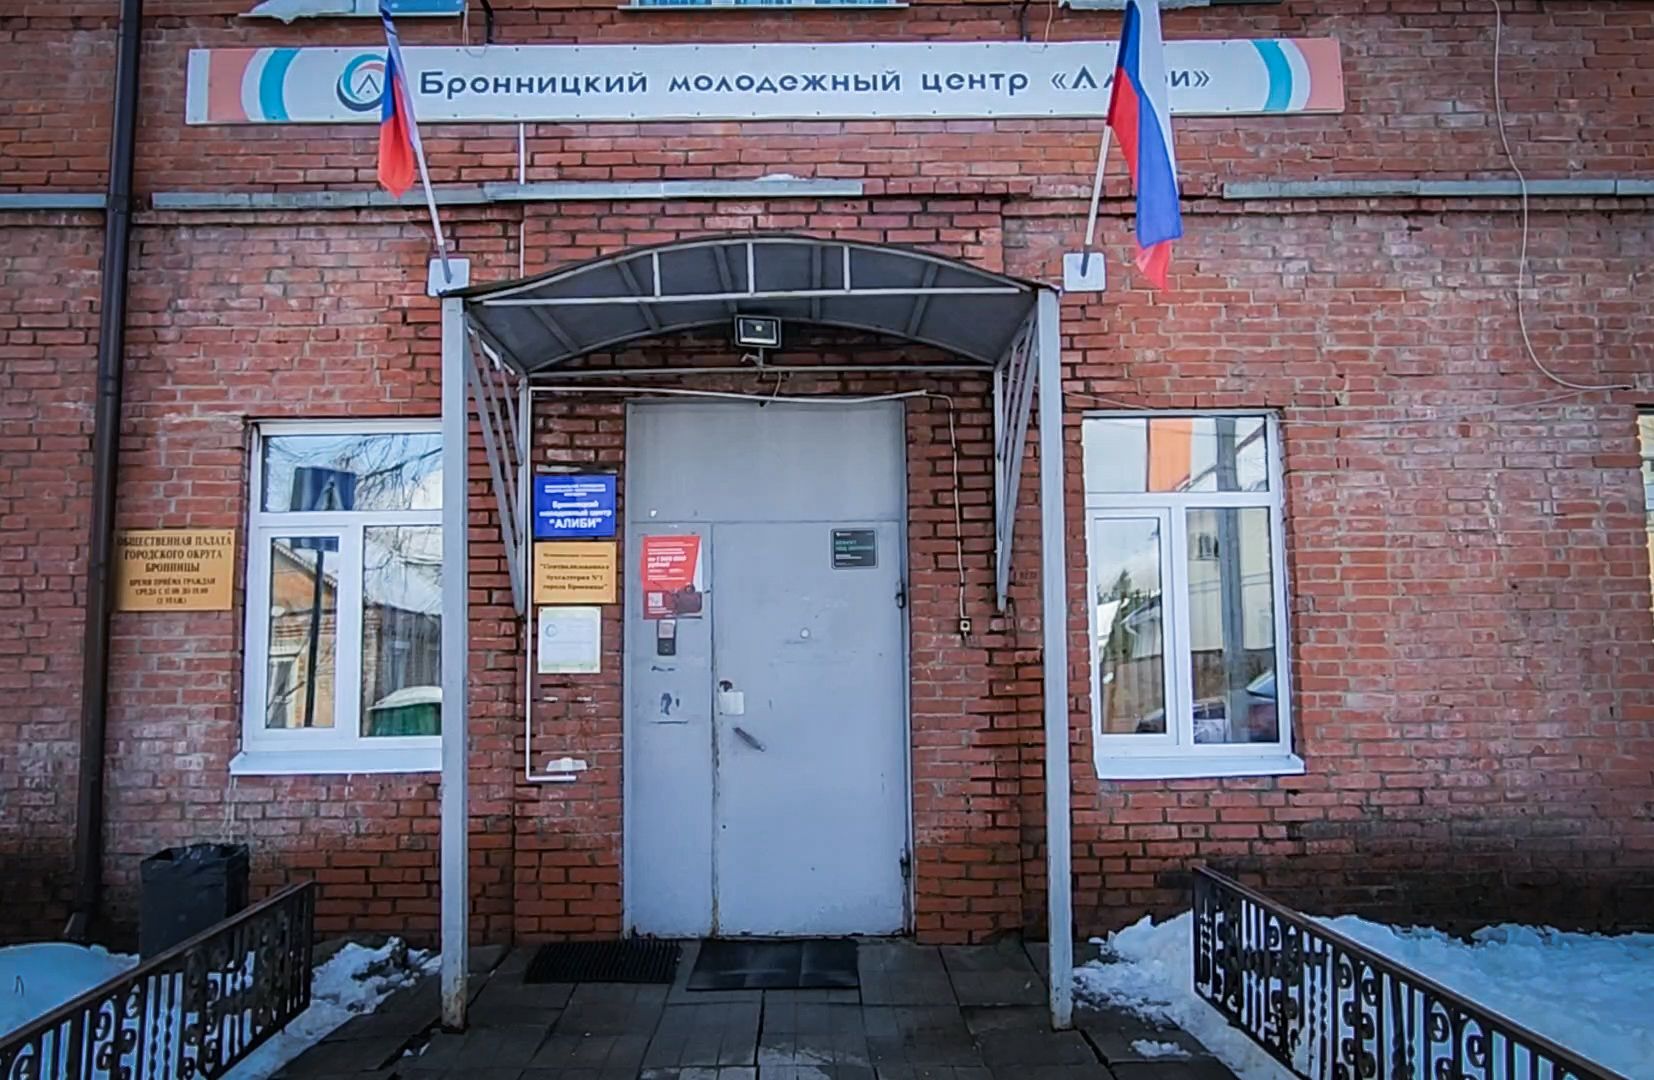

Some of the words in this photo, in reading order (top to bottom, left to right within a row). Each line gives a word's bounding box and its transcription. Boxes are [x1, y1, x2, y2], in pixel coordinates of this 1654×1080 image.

[420, 71, 648, 100] Бронницкий
[668, 69, 901, 94] молодежный
[921, 72, 1029, 96] центр
[549, 518, 602, 528] "АЛИБИ"
[195, 535, 232, 546] ПАЛАТА
[124, 549, 184, 560] ГОРОДСКОГО
[186, 549, 222, 560] ОКРУГА
[145, 562, 200, 572] БРОННИЦЫ
